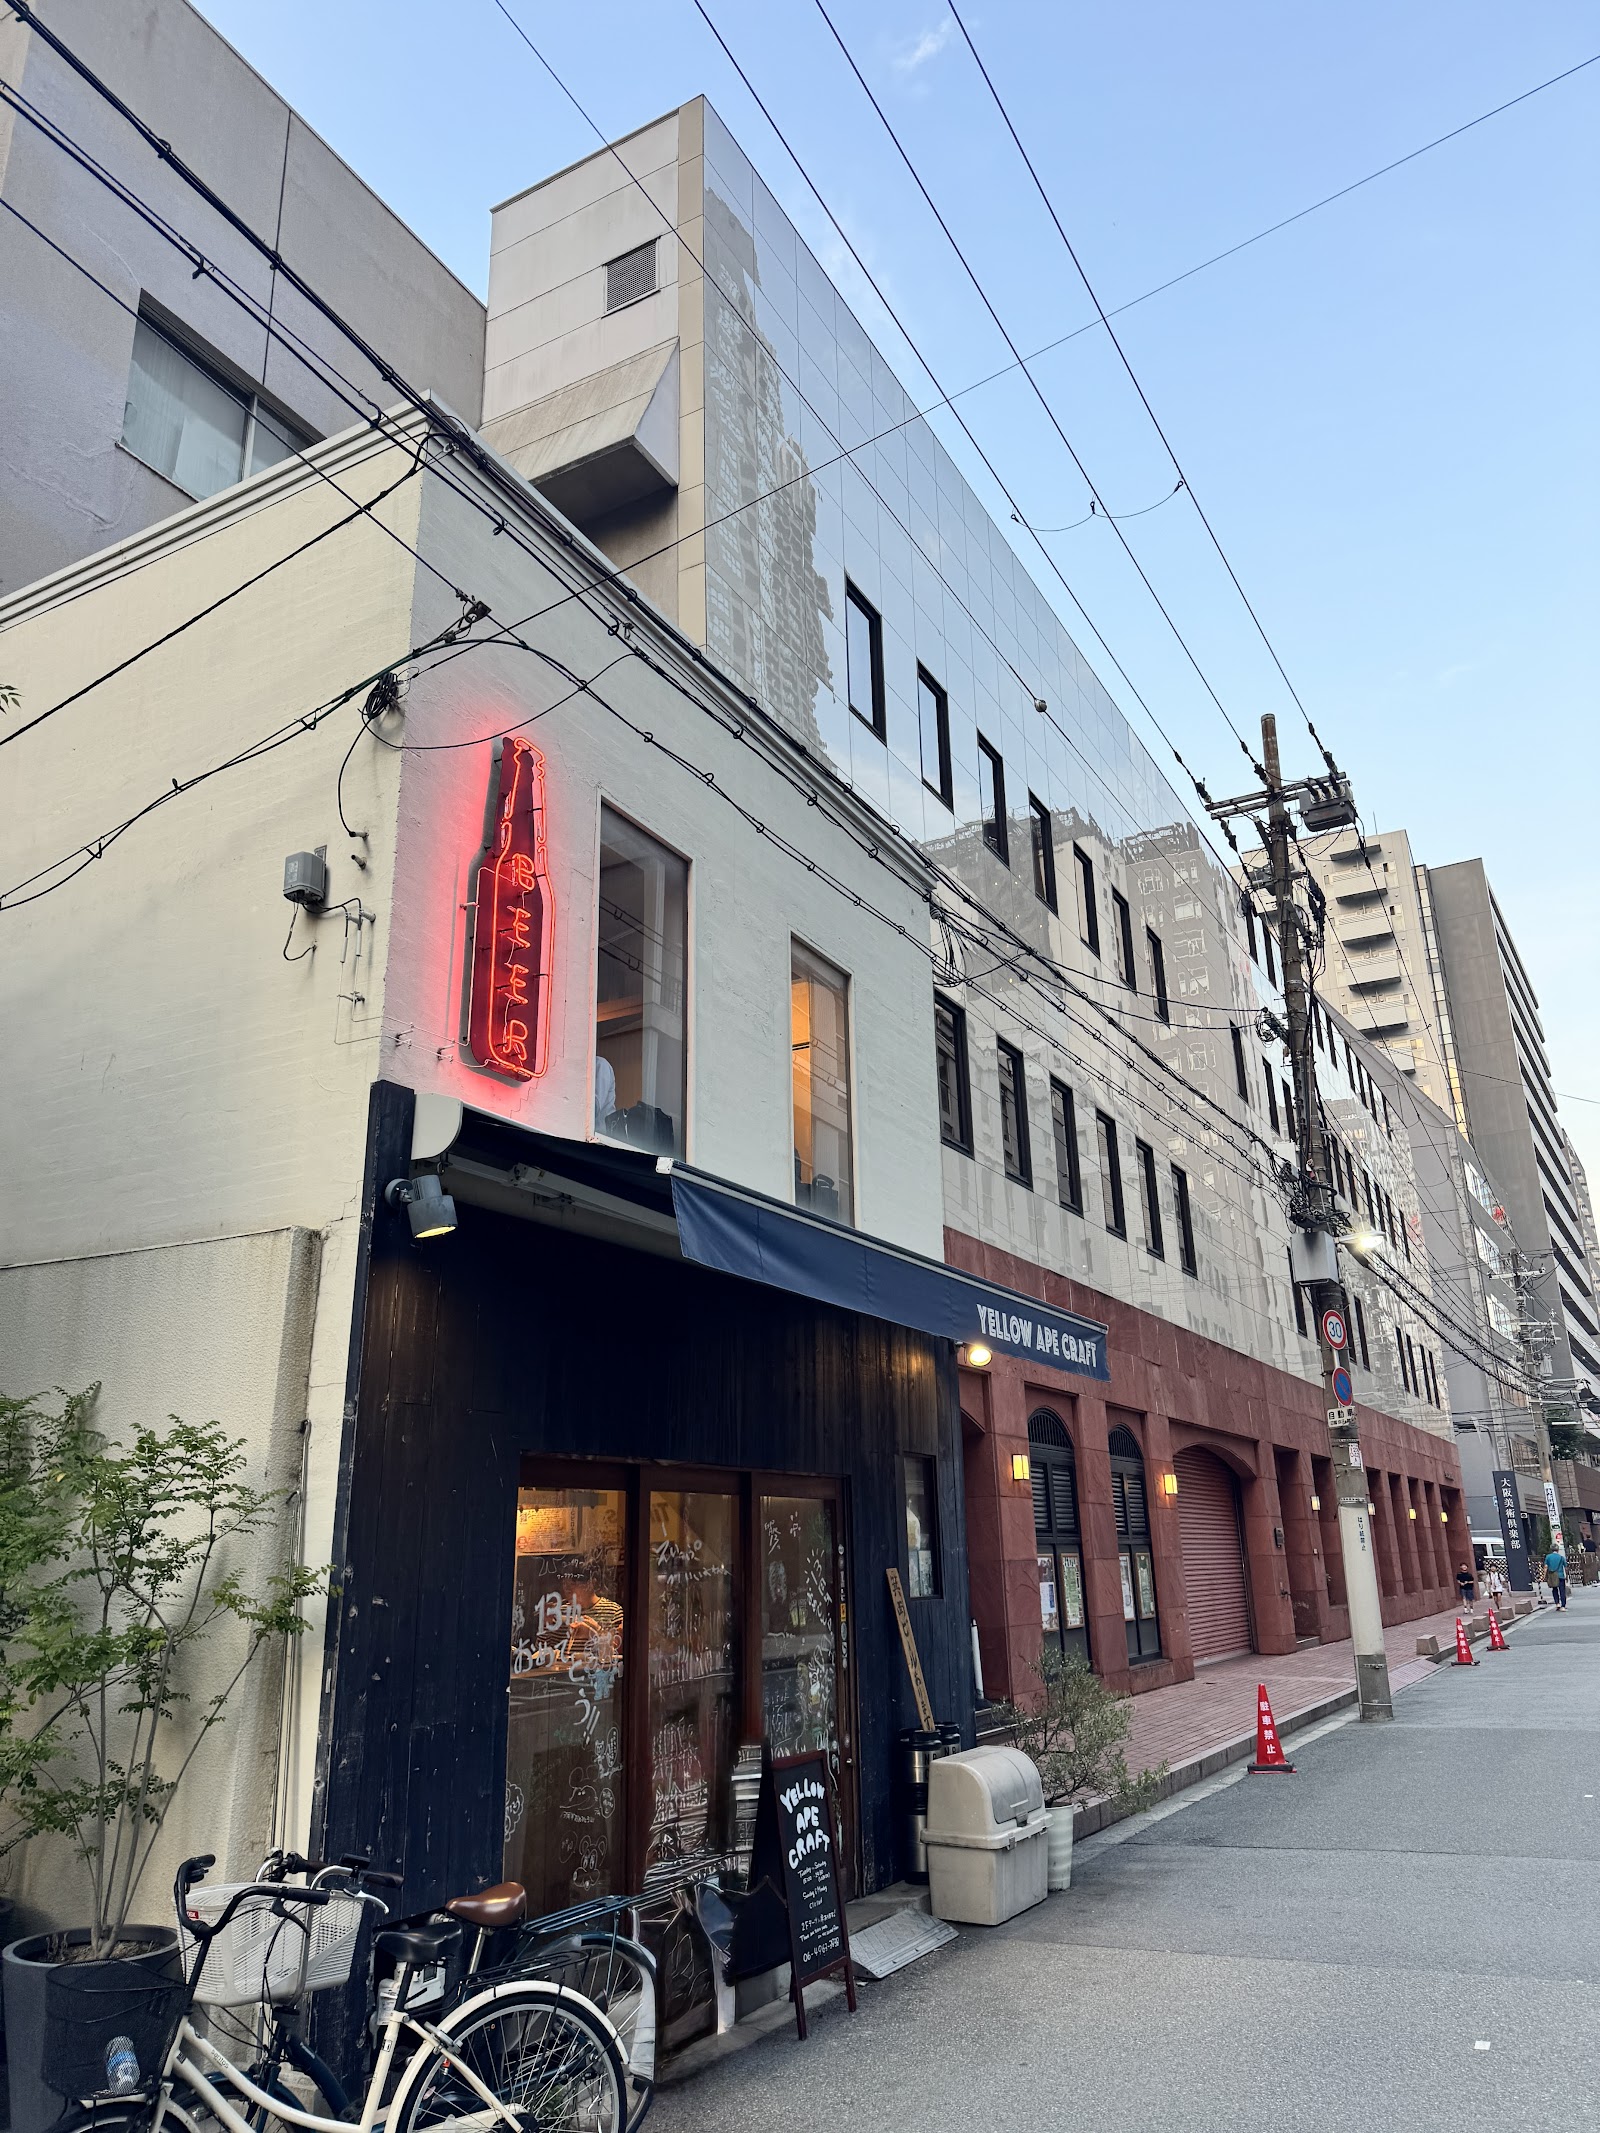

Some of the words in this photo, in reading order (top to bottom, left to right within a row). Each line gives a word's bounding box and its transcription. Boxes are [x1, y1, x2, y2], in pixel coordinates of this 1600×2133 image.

[504, 853, 535, 1062] BEER
[976, 1304, 1032, 1348] YELLOW
[1036, 1324, 1060, 1356] APE
[1061, 1332, 1097, 1368] CRAFT
[1328, 1321, 1342, 1339] 30
[1259, 1701, 1276, 1755] 駐車禁止
[779, 1777, 826, 1814] YELLOW
[796, 1805, 820, 1835] APE
[788, 1828, 831, 1870] CRAFT
